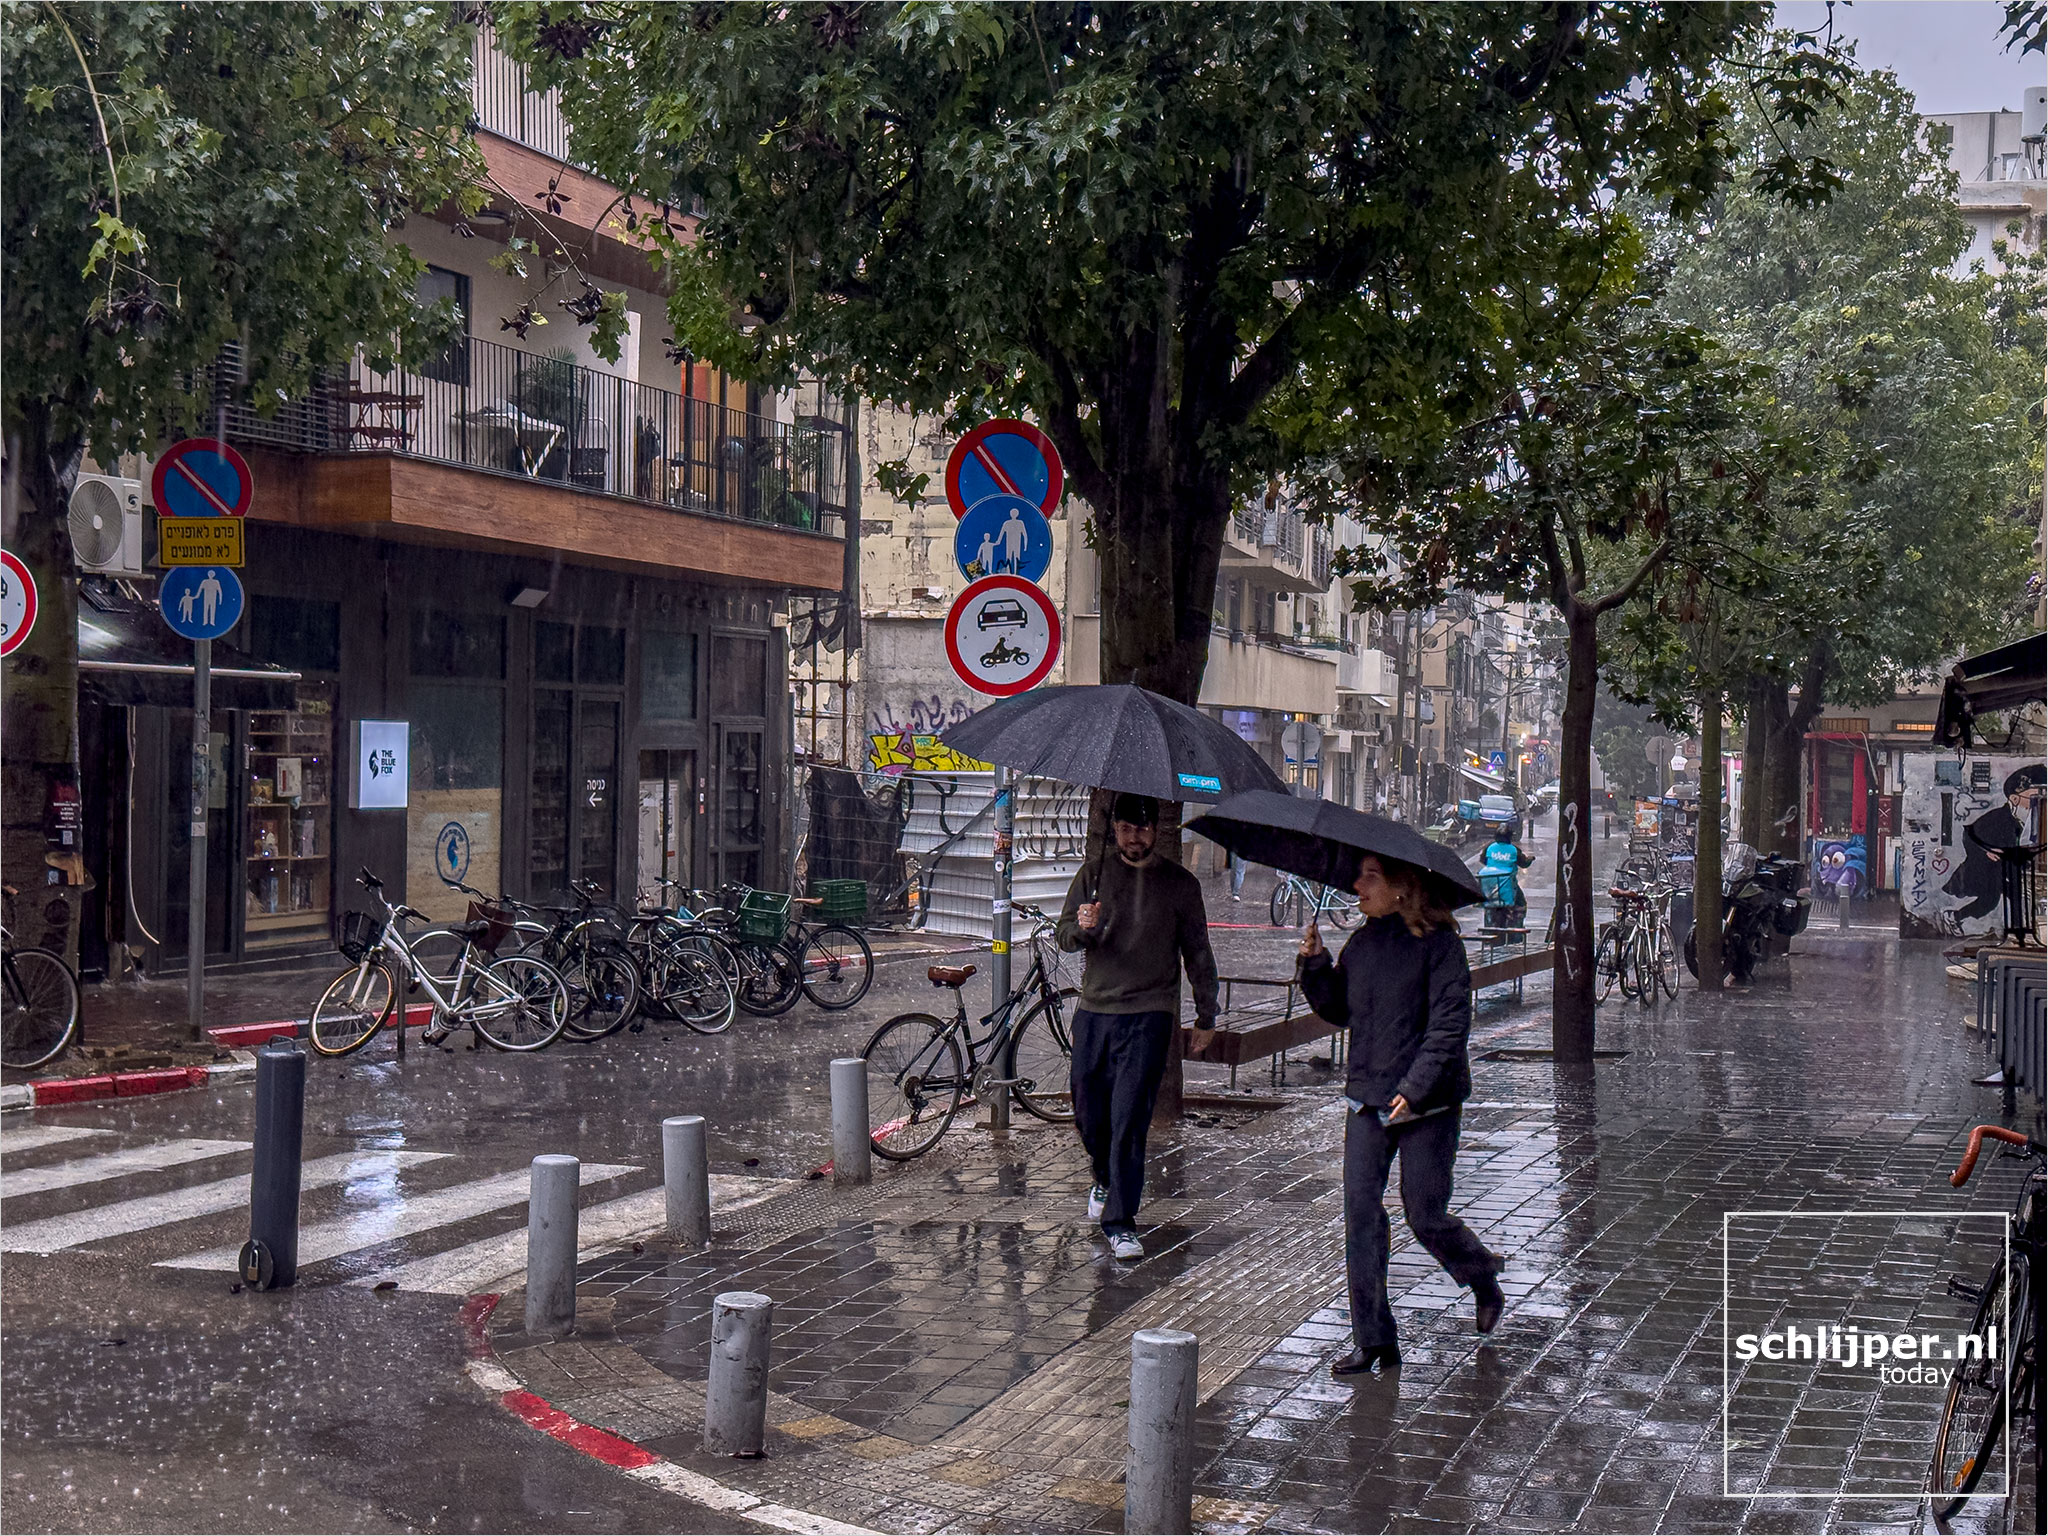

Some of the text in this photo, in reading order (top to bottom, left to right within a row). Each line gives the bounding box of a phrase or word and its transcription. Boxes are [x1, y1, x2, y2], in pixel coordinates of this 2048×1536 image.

[166, 524, 235, 539] פרט לאופניים
[171, 543, 230, 558] לא ממונעים
[381, 749, 393, 758] THE
[381, 758, 396, 766] BLUE
[381, 766, 393, 774] FOX
[586, 779, 606, 790] כניסה
